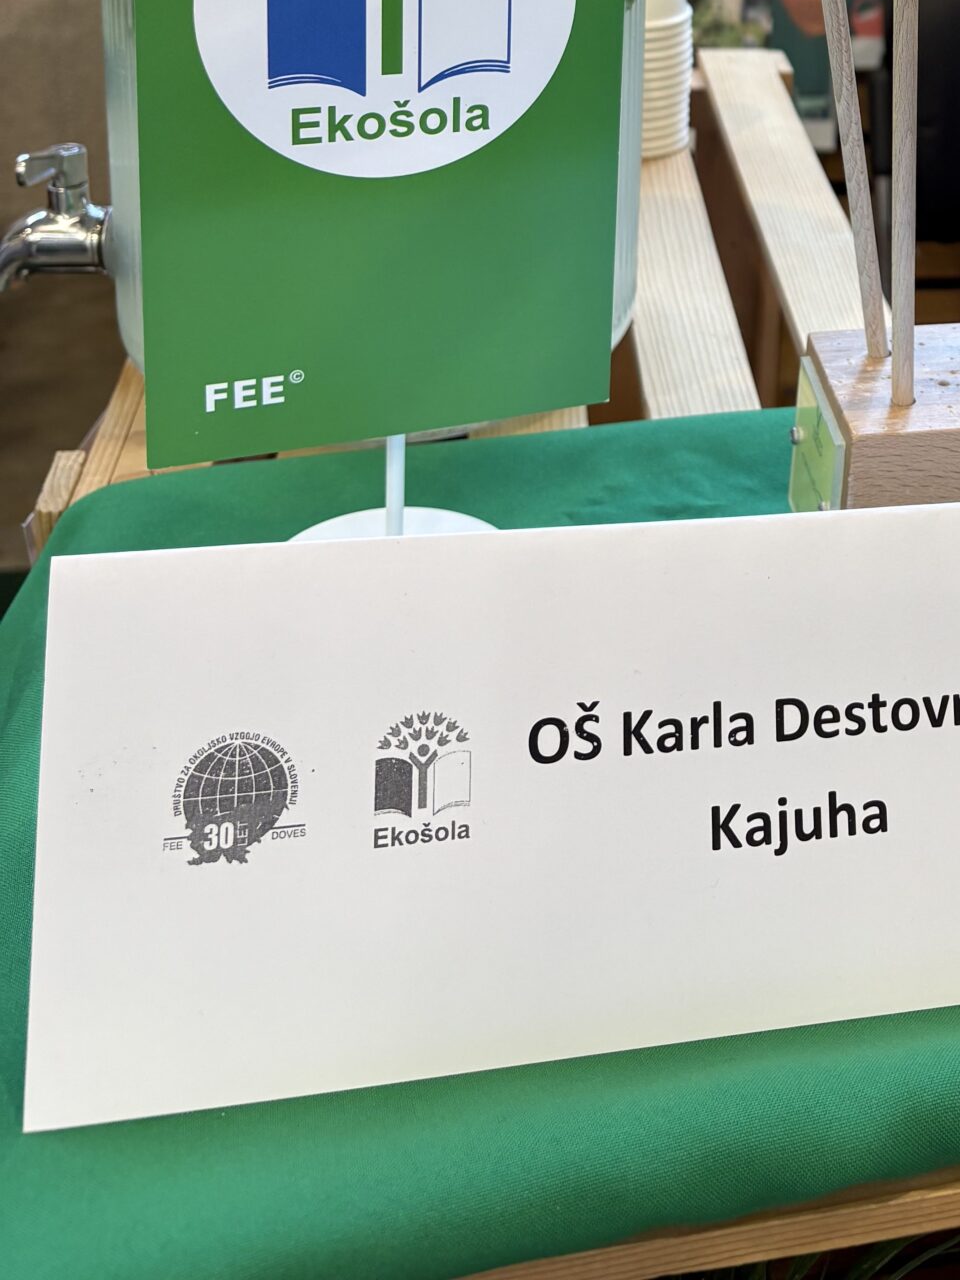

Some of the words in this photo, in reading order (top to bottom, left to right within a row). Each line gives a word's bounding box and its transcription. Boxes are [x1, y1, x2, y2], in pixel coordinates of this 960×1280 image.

[291, 97, 490, 146] Ekošola
[229, 732, 261, 742] VZGOJO
[528, 700, 602, 764] OŠ
[622, 700, 755, 756] Karla
[188, 735, 227, 765] OKOLJSKO
[261, 736, 288, 759] EVROPE
[284, 757, 292, 765] V
[181, 765, 192, 779] ZA
[287, 764, 299, 805] SLOVENIJI
[172, 777, 185, 817] DRUŠTVO
[203, 821, 235, 851] 30
[237, 821, 249, 846] LET
[271, 828, 306, 840] DOVES
[373, 820, 470, 849] Ekošola
[711, 790, 888, 856] Kajuha
[163, 841, 183, 851] FEE
